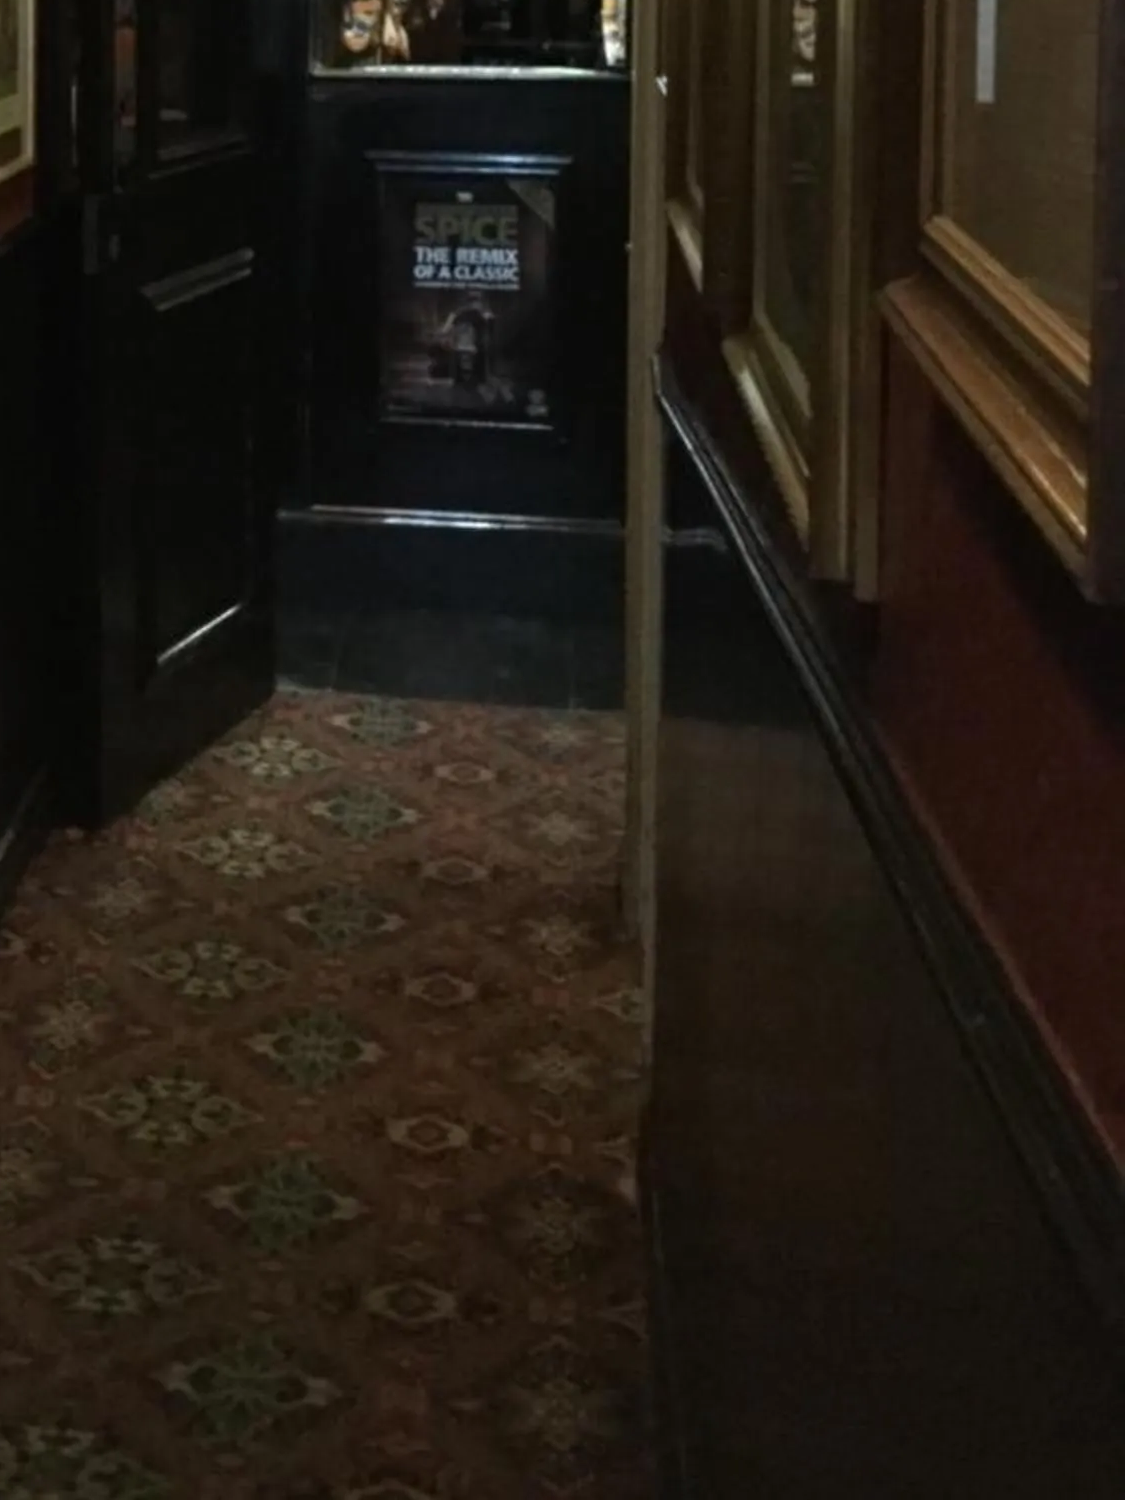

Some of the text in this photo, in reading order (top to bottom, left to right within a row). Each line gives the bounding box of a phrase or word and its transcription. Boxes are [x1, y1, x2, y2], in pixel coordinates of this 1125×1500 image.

[414, 214, 518, 245] SPICE
[413, 246, 518, 265] THE REMIX
[412, 264, 520, 281] OF A CLASSIC
